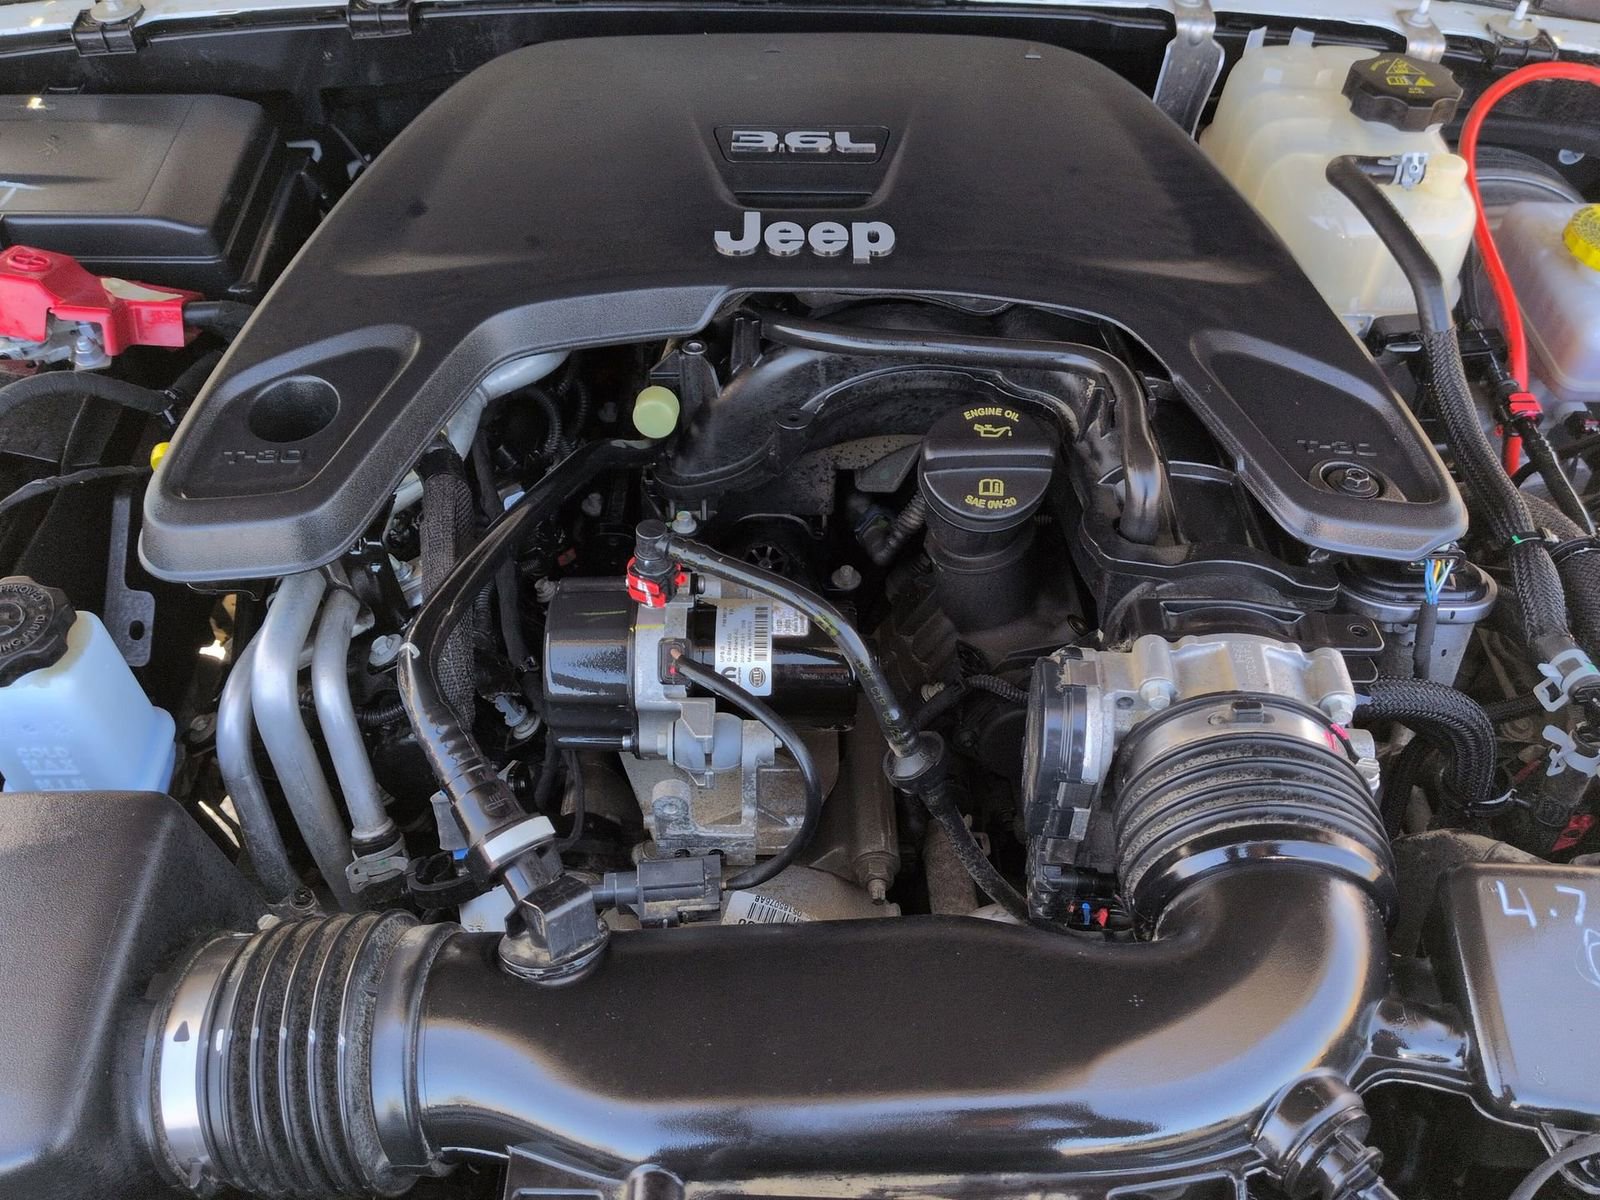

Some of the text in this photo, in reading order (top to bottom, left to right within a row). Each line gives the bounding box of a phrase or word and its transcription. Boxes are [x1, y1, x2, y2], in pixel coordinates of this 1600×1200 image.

[731, 130, 876, 153] 3.6L
[714, 211, 896, 264] Jeep
[963, 407, 1019, 422] ENGINE OIL
[223, 449, 301, 465] T-30
[964, 495, 1017, 509] SAE 0W-20
[0, 584, 44, 602] PPROVED
[22, 614, 46, 640] FLUID
[1495, 880, 1585, 928] 4.7
